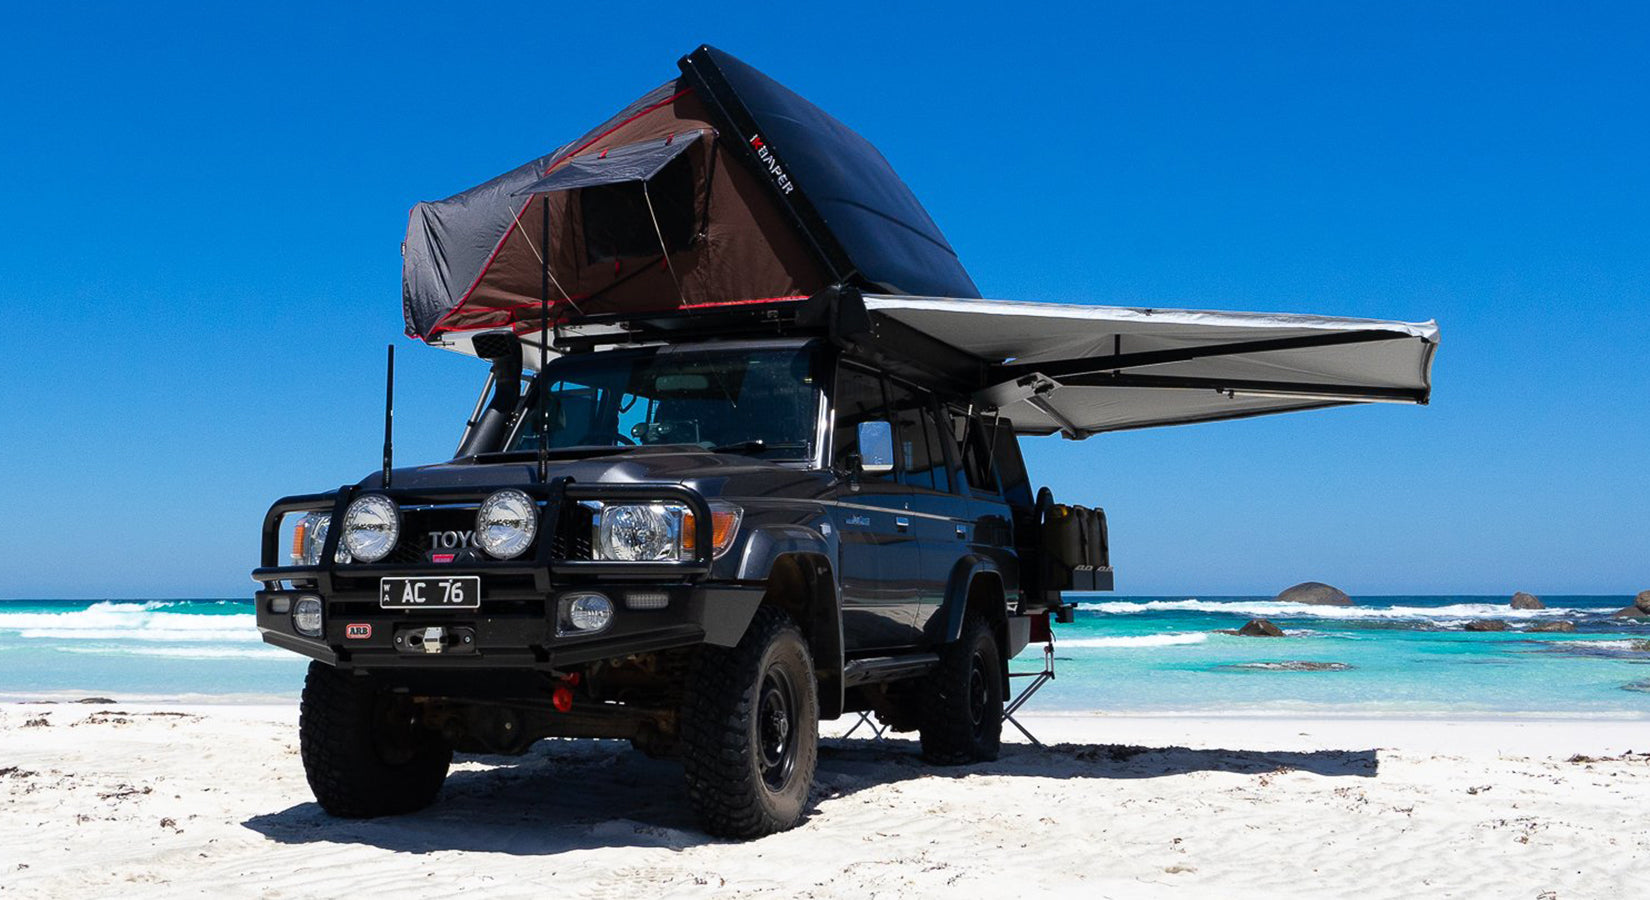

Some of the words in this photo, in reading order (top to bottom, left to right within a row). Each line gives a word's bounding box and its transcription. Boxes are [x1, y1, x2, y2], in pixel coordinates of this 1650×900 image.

[401, 582, 426, 603] AC
[438, 582, 464, 603] 76
[349, 626, 368, 635] ARB
